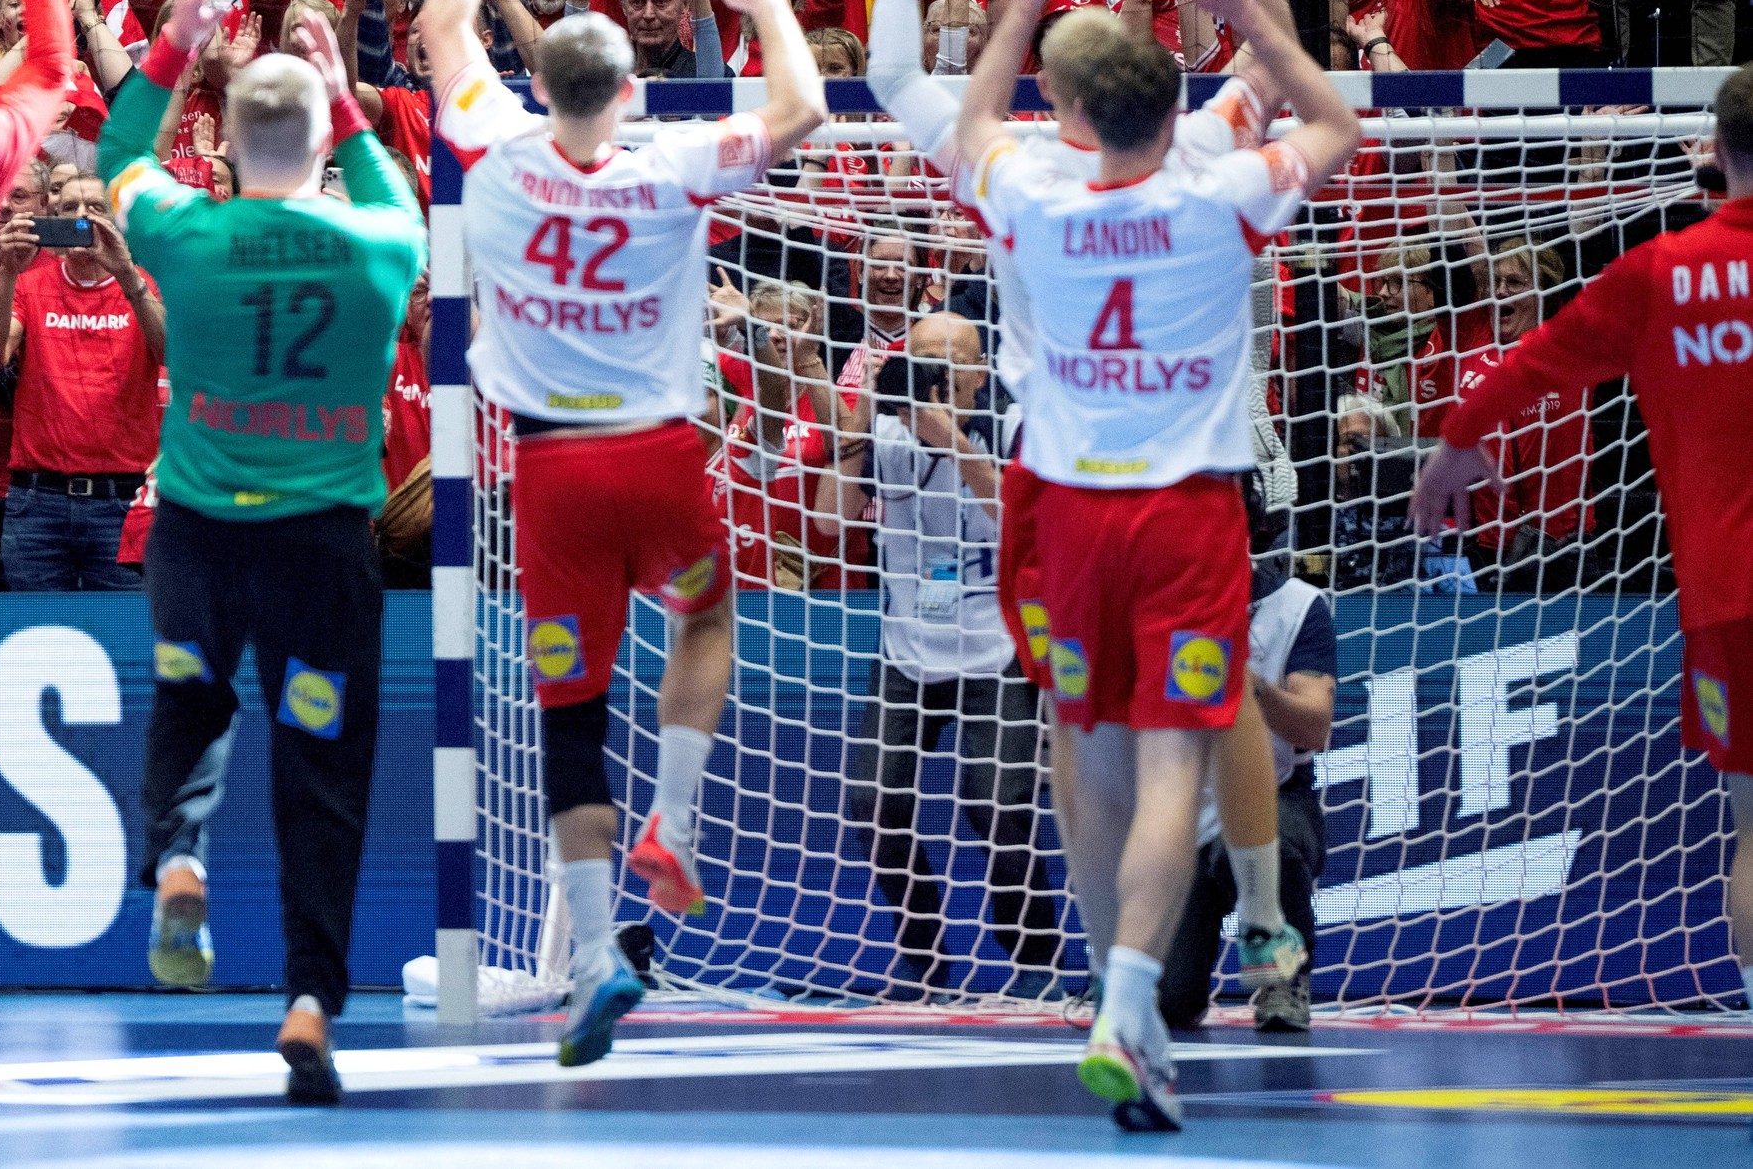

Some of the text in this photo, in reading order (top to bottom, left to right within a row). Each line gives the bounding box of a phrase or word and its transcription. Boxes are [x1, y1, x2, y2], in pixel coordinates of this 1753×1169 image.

[524, 216, 630, 292] 42
[1062, 216, 1172, 258] LANDIN
[45, 312, 130, 330] DANMARK
[241, 281, 337, 380] 12
[495, 284, 661, 336] NORLYS
[1087, 277, 1143, 350] 4
[1046, 349, 1214, 393] NORLYS
[189, 389, 369, 445] NORLYS
